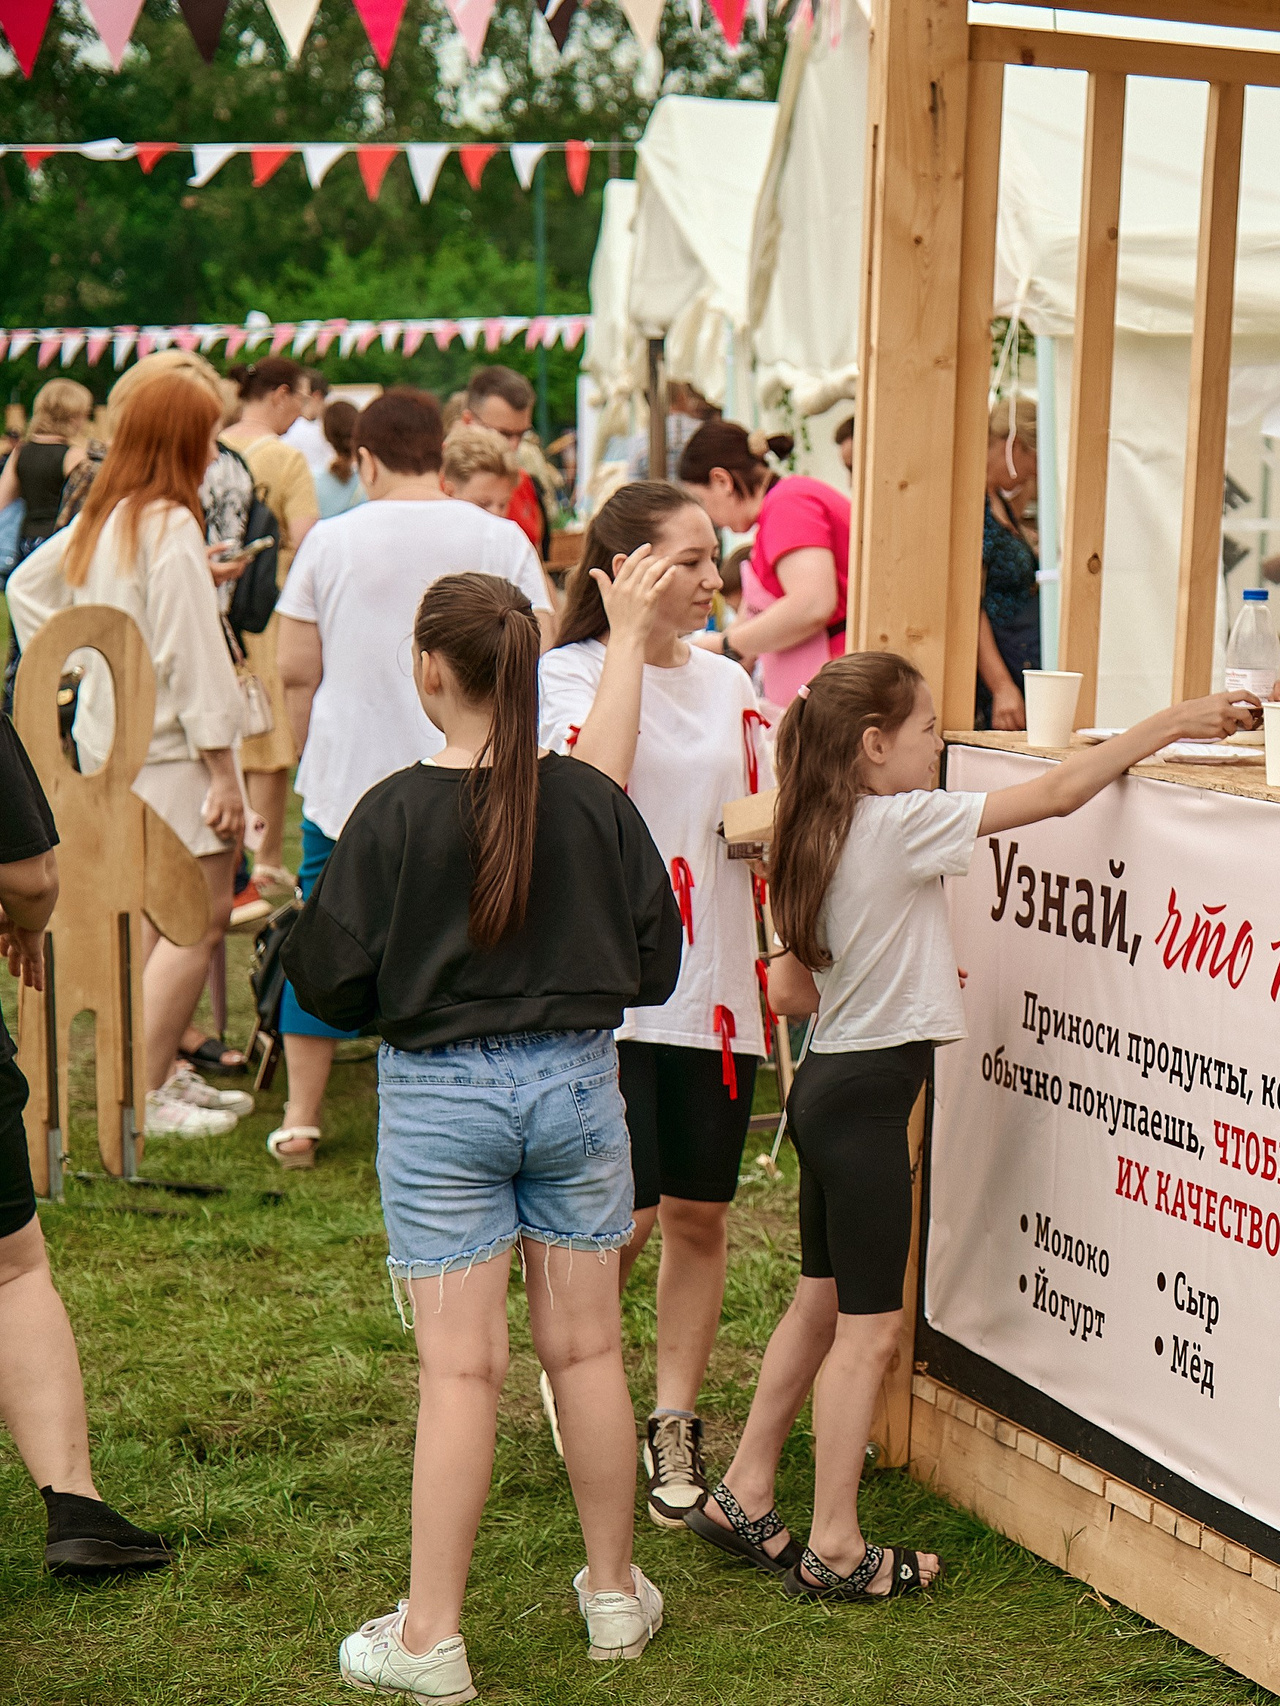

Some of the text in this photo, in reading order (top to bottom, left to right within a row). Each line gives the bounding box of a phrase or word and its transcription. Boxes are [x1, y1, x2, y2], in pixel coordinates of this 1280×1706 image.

[988, 838, 1142, 967] Узнай,
[1155, 887, 1254, 990] что
[1022, 991, 1120, 1058] Приноси
[1127, 1033, 1254, 1106] продукты,
[982, 1053, 1063, 1106] обычно
[1068, 1081, 1205, 1161] покупаешь,
[1116, 1156, 1150, 1207] ИХ
[1035, 1212, 1110, 1278] Молоко
[1033, 1266, 1106, 1343] Йогурт
[1174, 1272, 1220, 1335] Сыр
[1171, 1335, 1215, 1400] Мёд
